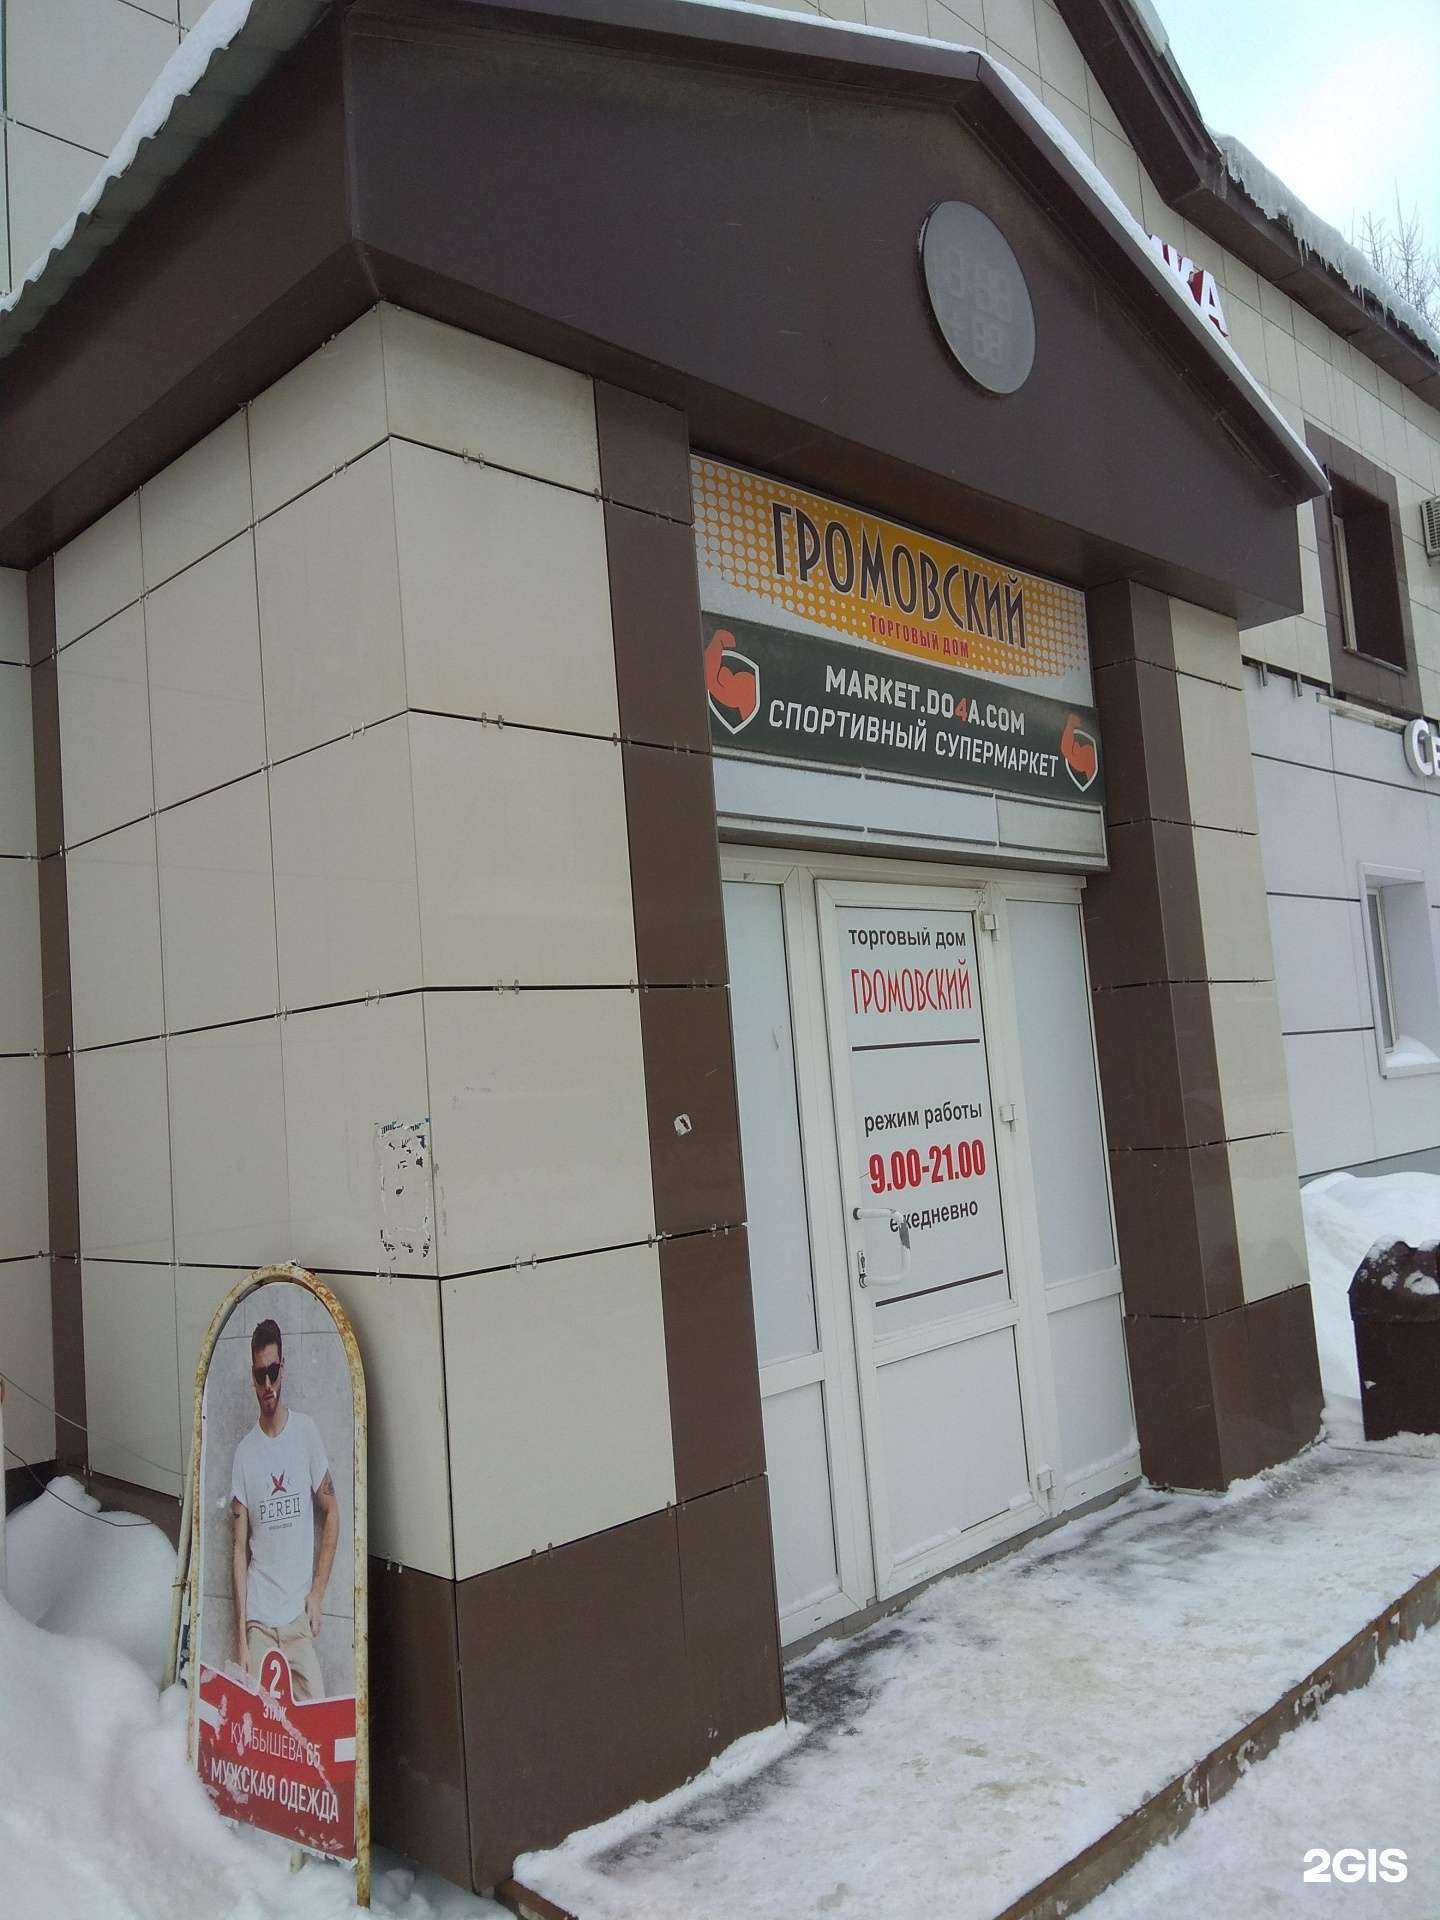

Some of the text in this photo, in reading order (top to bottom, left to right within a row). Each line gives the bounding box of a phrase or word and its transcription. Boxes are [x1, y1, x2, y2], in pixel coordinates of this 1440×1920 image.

[771, 501, 1027, 650] ГРОМОВСКИЙ
[870, 613, 969, 659] ТОРГОВЫЙ ДОМ
[825, 664, 1026, 736] MARKET.DO4A.COM
[768, 699, 1059, 778] СПОРТИВНЫЙ СУПЕРМАРКЕТ
[848, 927, 967, 949] торговый дом
[850, 957, 972, 1014] ГРОМОВСКИЙ
[864, 1101, 983, 1138] режим работы
[868, 1138, 987, 1194] 9.00-21.00
[269, 1659, 283, 1700] 2
[230, 1720, 322, 1767] КУБЫШЕВА 65
[211, 1757, 340, 1824] МУЖСКАЯ ОДЕЖДА
